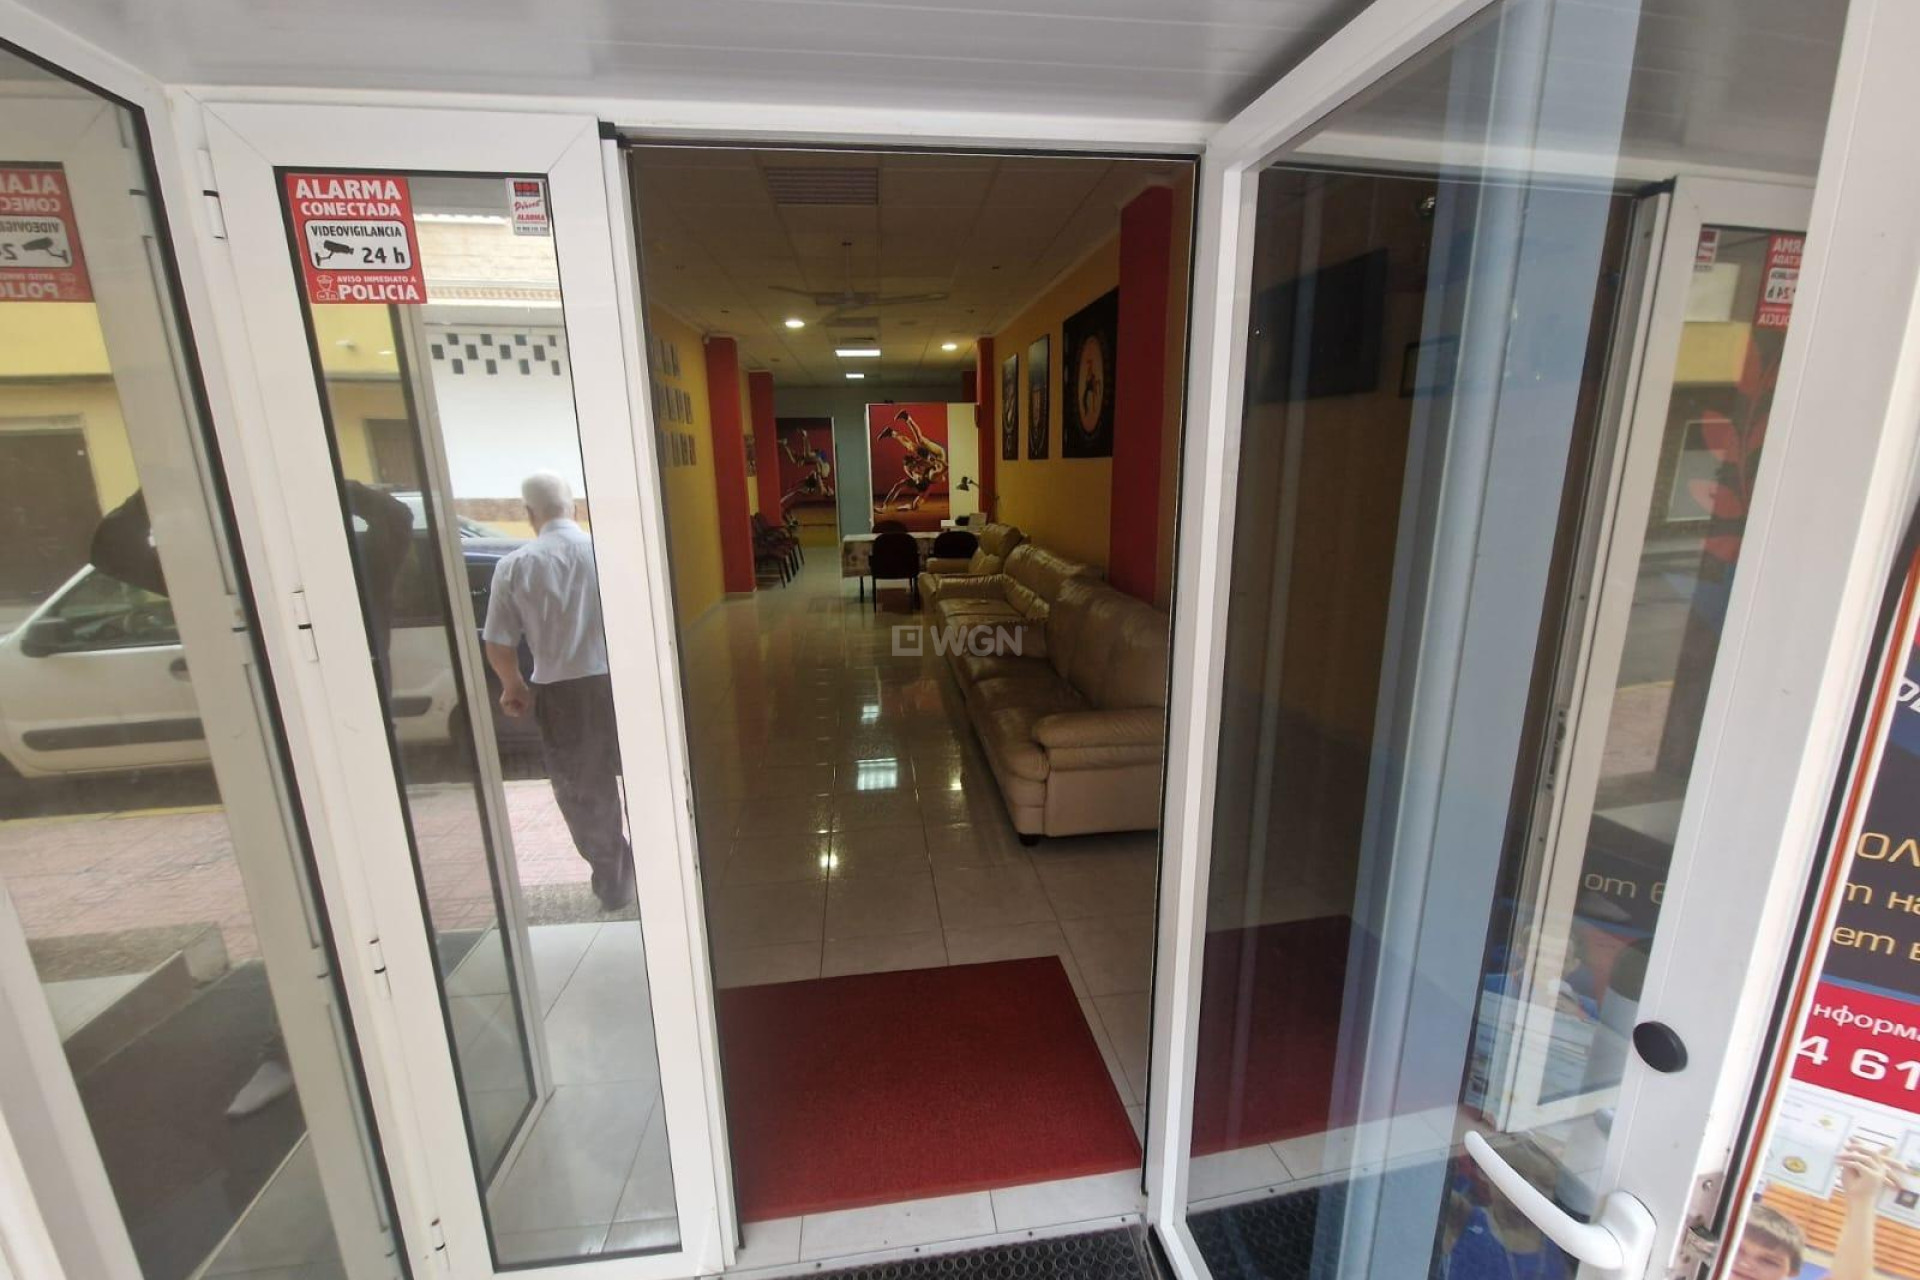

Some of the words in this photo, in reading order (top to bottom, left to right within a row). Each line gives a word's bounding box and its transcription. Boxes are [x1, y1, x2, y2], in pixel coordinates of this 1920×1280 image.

[296, 179, 402, 200] ALARMA
[301, 201, 401, 216] CONECTADA
[311, 225, 402, 238] VIDEOVIGILANCIA
[362, 247, 387, 264] 24
[394, 247, 405, 264] h
[337, 275, 361, 283] AVISO
[364, 275, 408, 284] INMEDIATO
[338, 284, 420, 300] POLICIA
[1797, 1035, 1829, 1067] 4
[1850, 1048, 1920, 1091] 61
